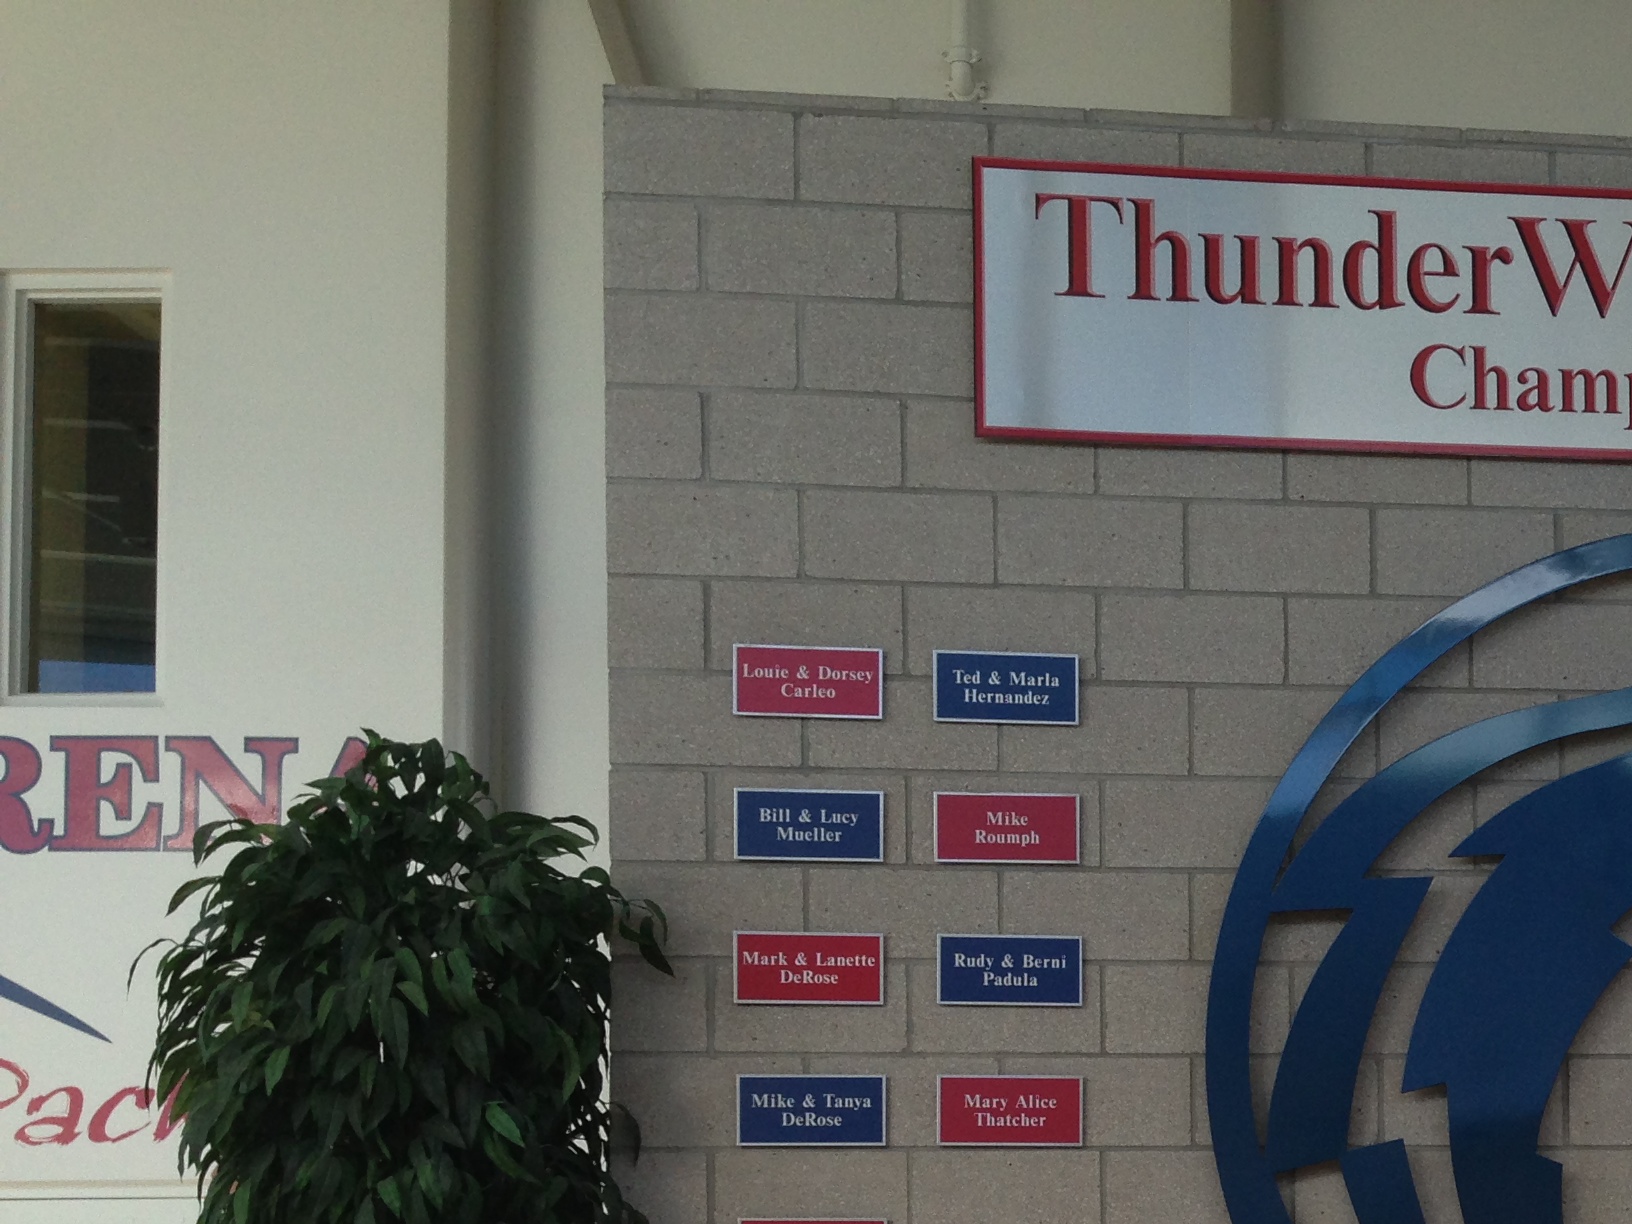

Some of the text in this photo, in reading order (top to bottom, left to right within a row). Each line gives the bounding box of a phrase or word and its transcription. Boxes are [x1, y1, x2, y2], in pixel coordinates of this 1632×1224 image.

[743, 664, 874, 684] Louie & Dorsey
[953, 670, 1060, 687] Ted & Marla
[781, 683, 836, 699] Carleo
[965, 689, 1050, 705] Hernandez
[760, 808, 859, 827] Bill & Lucy
[987, 812, 1028, 826] Mike
[778, 827, 842, 842] Mueller
[975, 830, 1040, 847] Roumph
[743, 952, 876, 967] Mark & Lanette
[954, 953, 1066, 970] Rudy & Berni
[781, 970, 839, 985] DeRose
[982, 972, 1038, 987] Padula
[752, 1094, 872, 1111] Mike & Tanya
[964, 1094, 1057, 1112] Mary Alice
[783, 1113, 843, 1127] DeRose
[974, 1113, 1047, 1127] Thatcher
